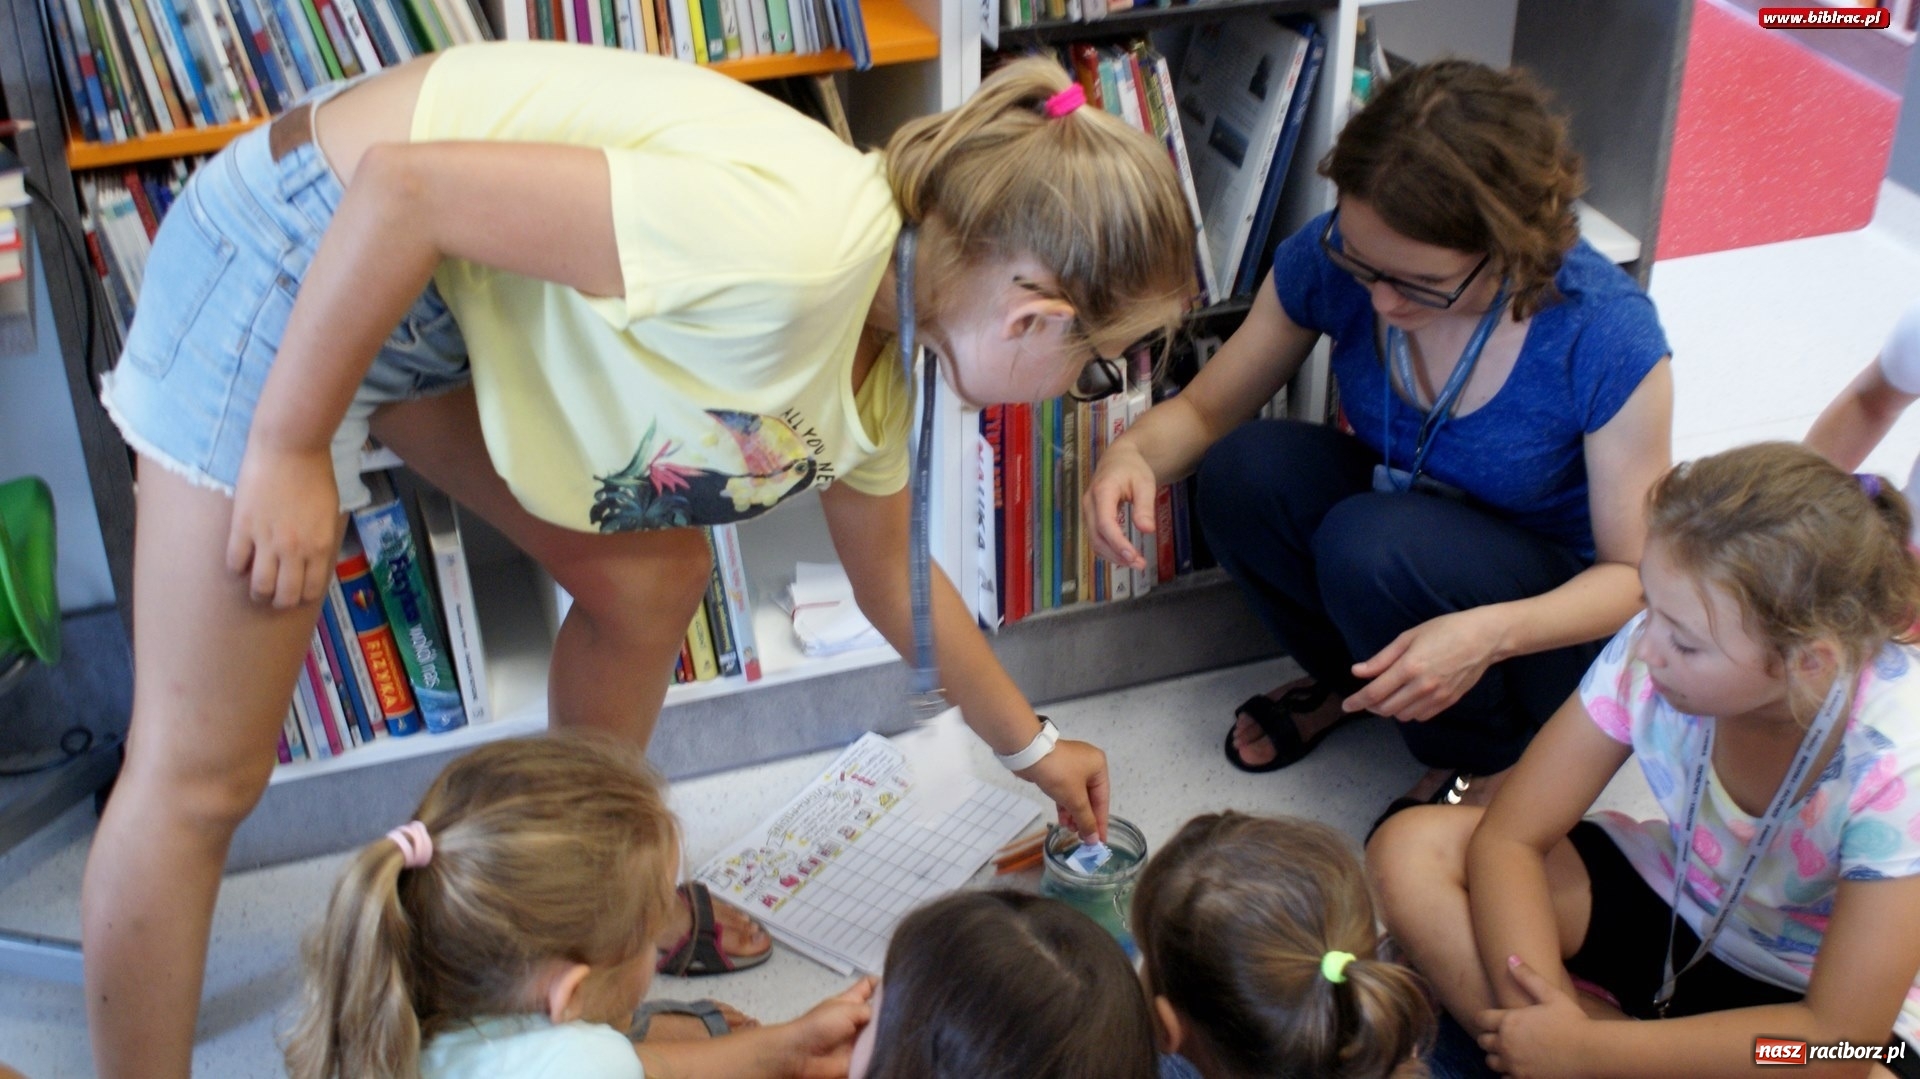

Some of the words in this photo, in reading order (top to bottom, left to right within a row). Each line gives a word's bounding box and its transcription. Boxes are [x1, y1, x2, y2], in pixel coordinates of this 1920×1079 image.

[781, 406, 805, 431] ALL
[801, 426, 826, 456] YOU
[814, 461, 836, 489] NE
[409, 622, 438, 665] wokół
[366, 639, 397, 708] FIZYKA
[421, 661, 441, 690] nas
